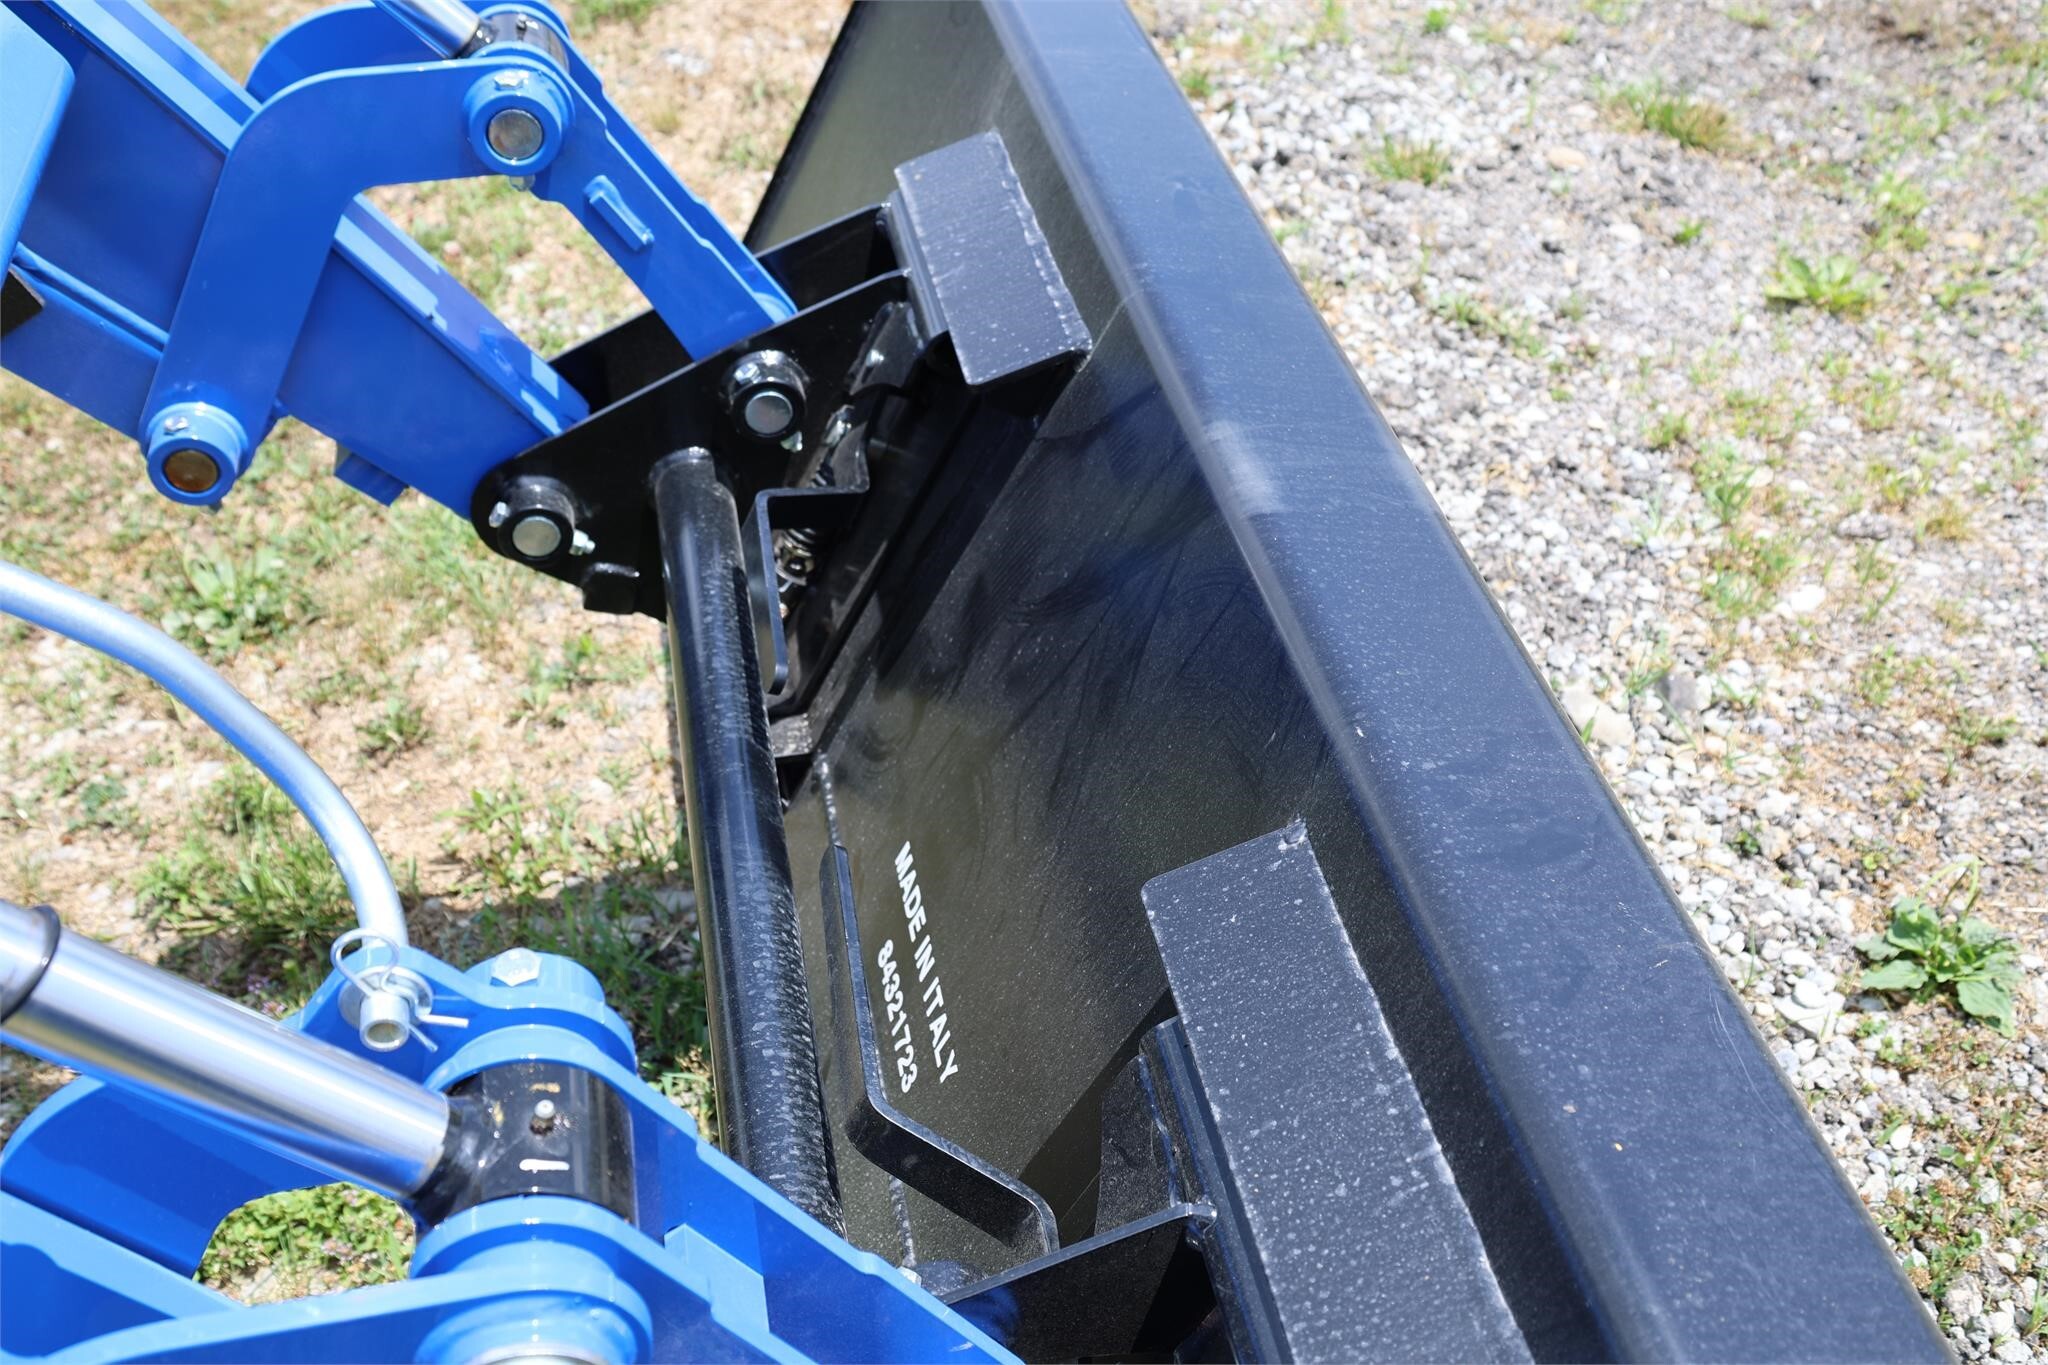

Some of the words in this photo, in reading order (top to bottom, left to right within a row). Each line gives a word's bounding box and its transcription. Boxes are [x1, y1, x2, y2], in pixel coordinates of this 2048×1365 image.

[894, 841, 927, 942] MADE
[914, 934, 935, 982] IN
[878, 939, 918, 1093] 84321723
[923, 976, 958, 1083] ITALY
